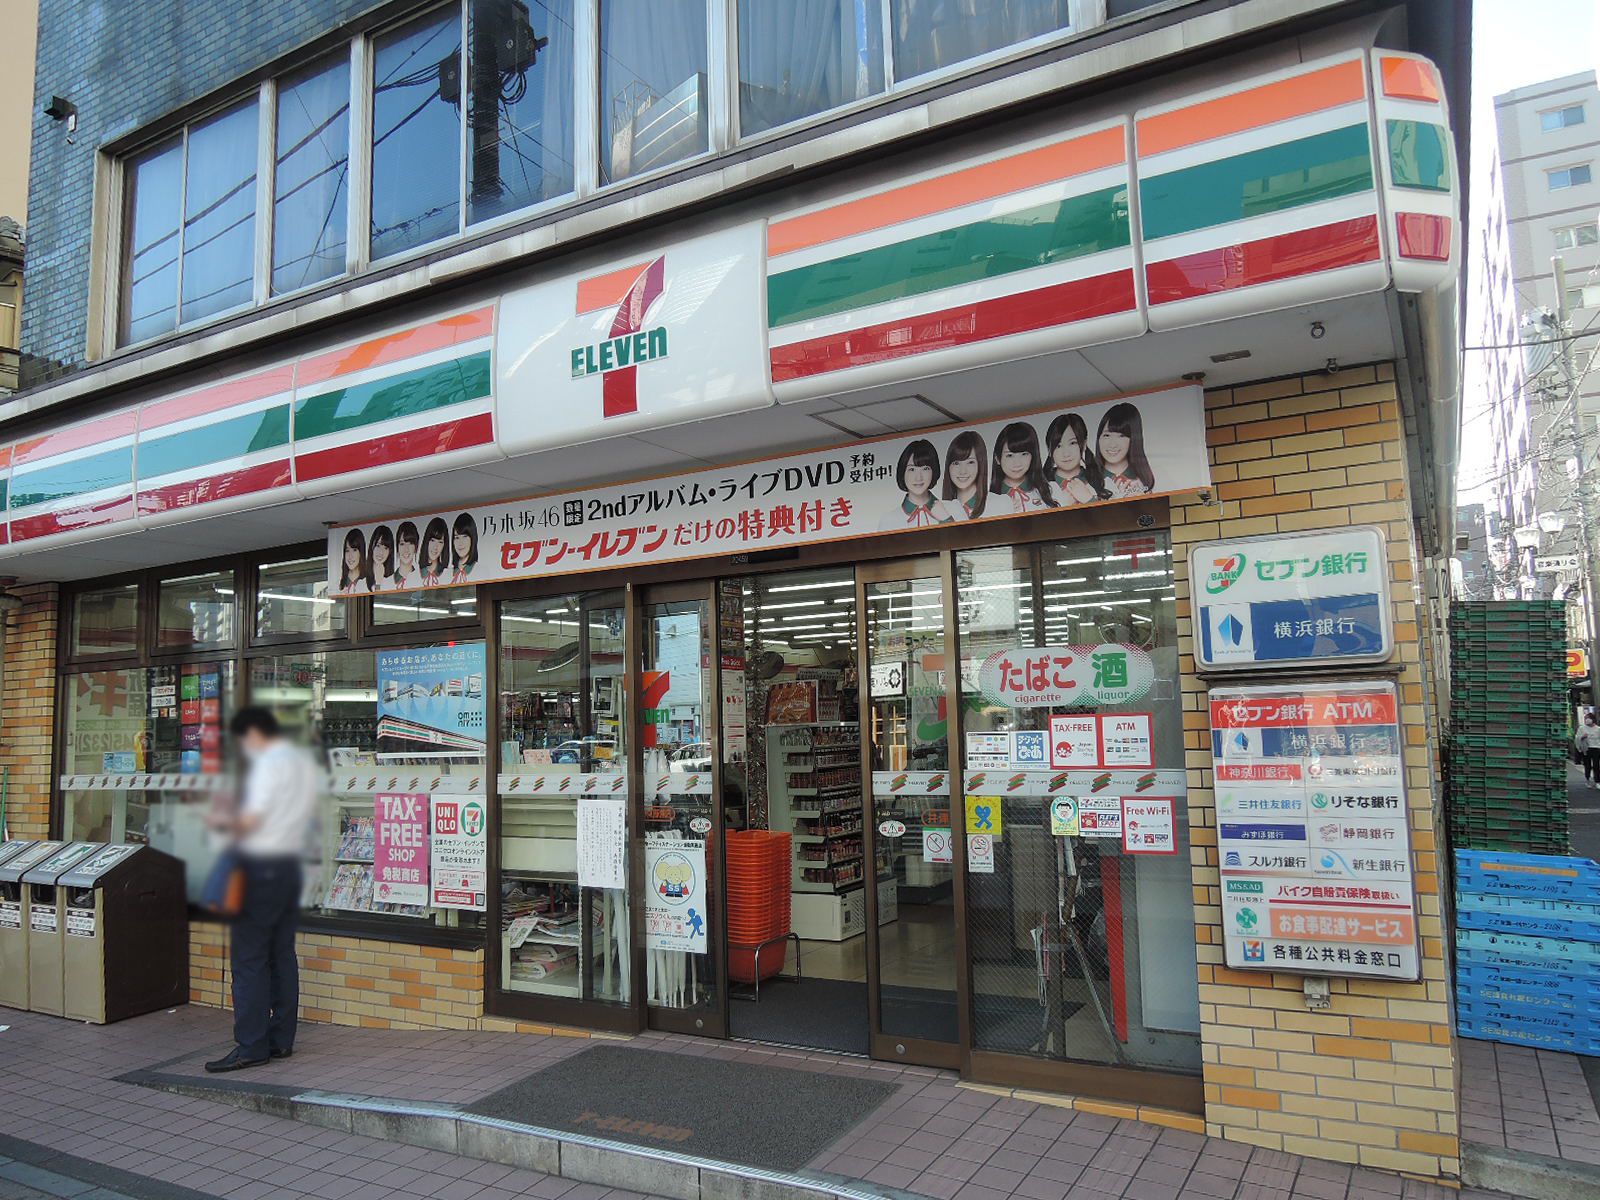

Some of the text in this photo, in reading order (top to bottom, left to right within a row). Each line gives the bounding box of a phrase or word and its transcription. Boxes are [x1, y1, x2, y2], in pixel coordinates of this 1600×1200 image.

[849, 453, 875, 468] 予約
[482, 505, 560, 536] 乃木坂46
[674, 497, 854, 547] だけの特典付き
[1254, 552, 1367, 581] セブン銀行
[1210, 571, 1239, 582] BANK
[1274, 617, 1356, 639] 横浜銀行
[999, 652, 1128, 692] たばこ 酒
[1015, 689, 1130, 704] cigarette liquor
[1233, 702, 1373, 722] セブン銀行 ATM
[1054, 723, 1093, 732] TAX-FREE
[1115, 722, 1136, 731] ATM
[1291, 733, 1366, 749] 横浜銀行
[1229, 765, 1288, 779] 神奈川銀行
[380, 797, 422, 821] TAX-
[1238, 800, 1302, 810] 三井住友銀行
[1331, 796, 1399, 809] りそな銀行
[437, 807, 455, 818] UNI
[1126, 806, 1170, 815] Free Wi-Fi
[437, 820, 456, 831] QLO
[380, 823, 422, 848] FREE
[1241, 831, 1284, 839] みずほ銀行
[1343, 828, 1395, 840] 静岡銀行
[388, 849, 416, 863] SHOP
[1248, 855, 1307, 868] スルガ銀行
[1352, 858, 1406, 873] 新生銀行
[1279, 915, 1404, 938] お食事配達サービス
[1273, 944, 1401, 968] 各種公共料金窓口
